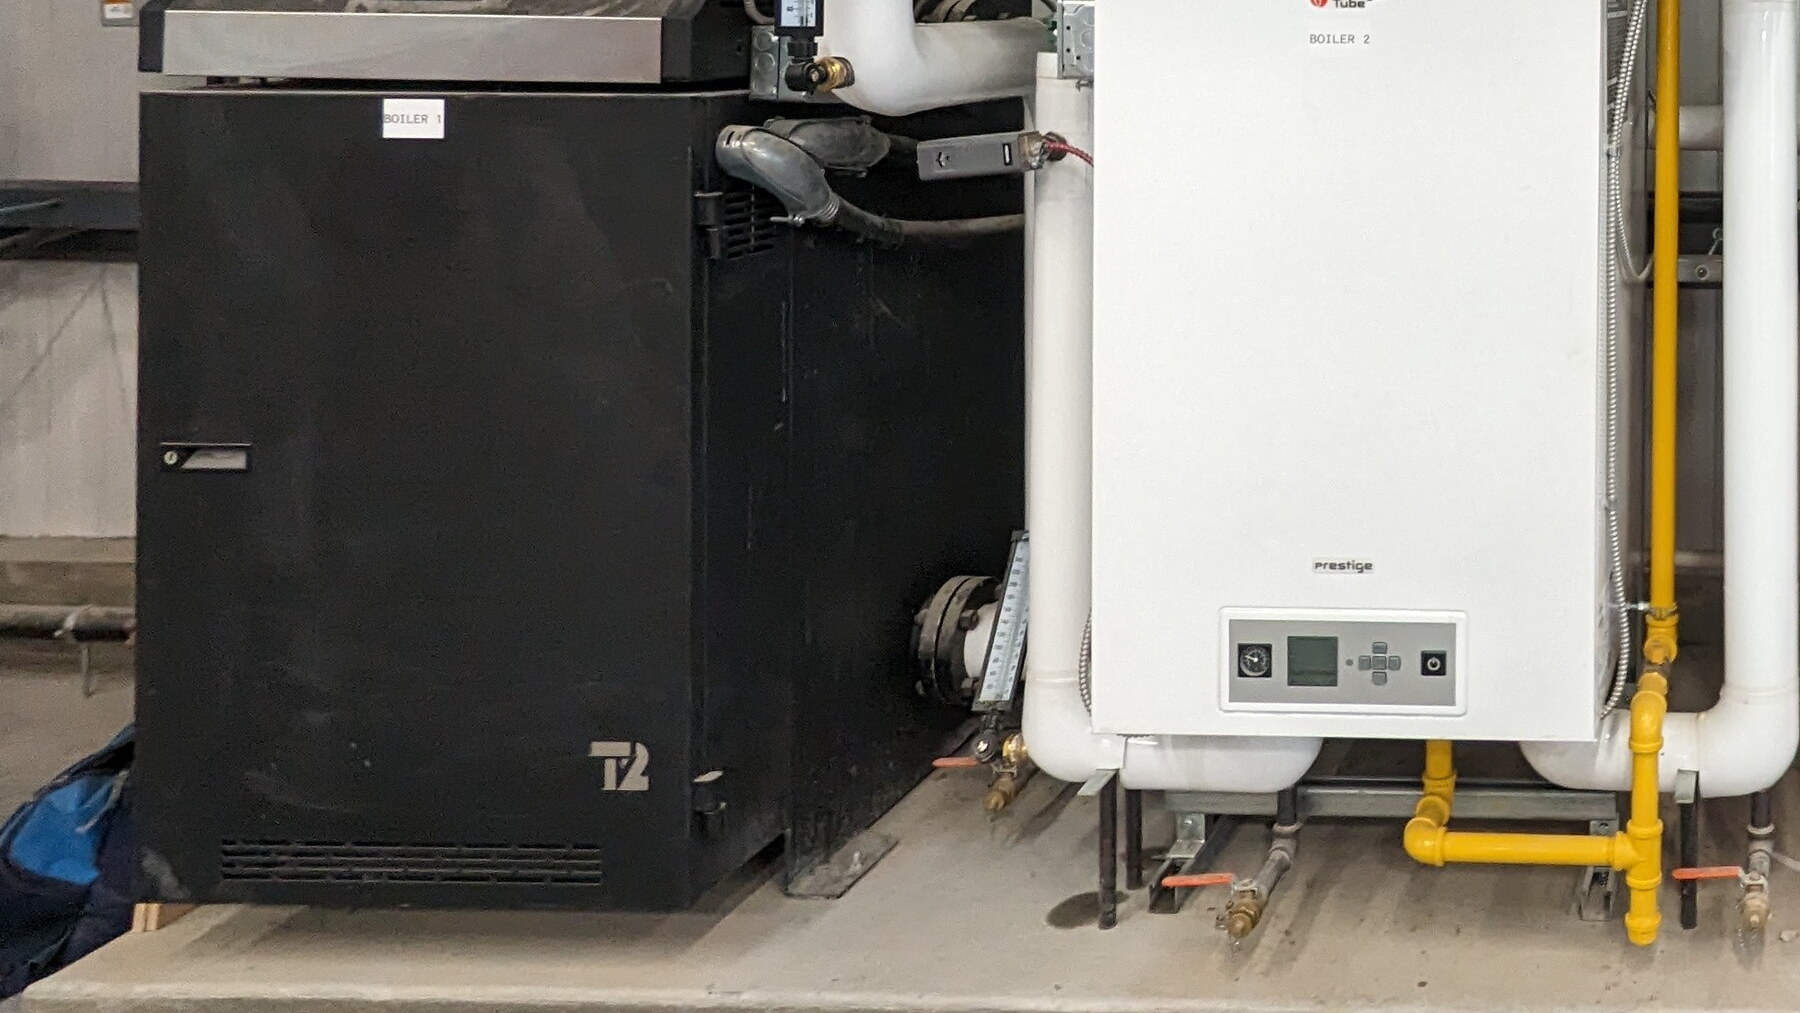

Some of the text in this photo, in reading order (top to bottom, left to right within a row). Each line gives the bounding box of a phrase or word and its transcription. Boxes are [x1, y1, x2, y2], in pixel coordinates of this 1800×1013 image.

[1309, 34, 1370, 44] BOILER 2
[384, 113, 441, 124] BOILER 1
[1315, 560, 1373, 573] prestige
[587, 741, 650, 791] T2
